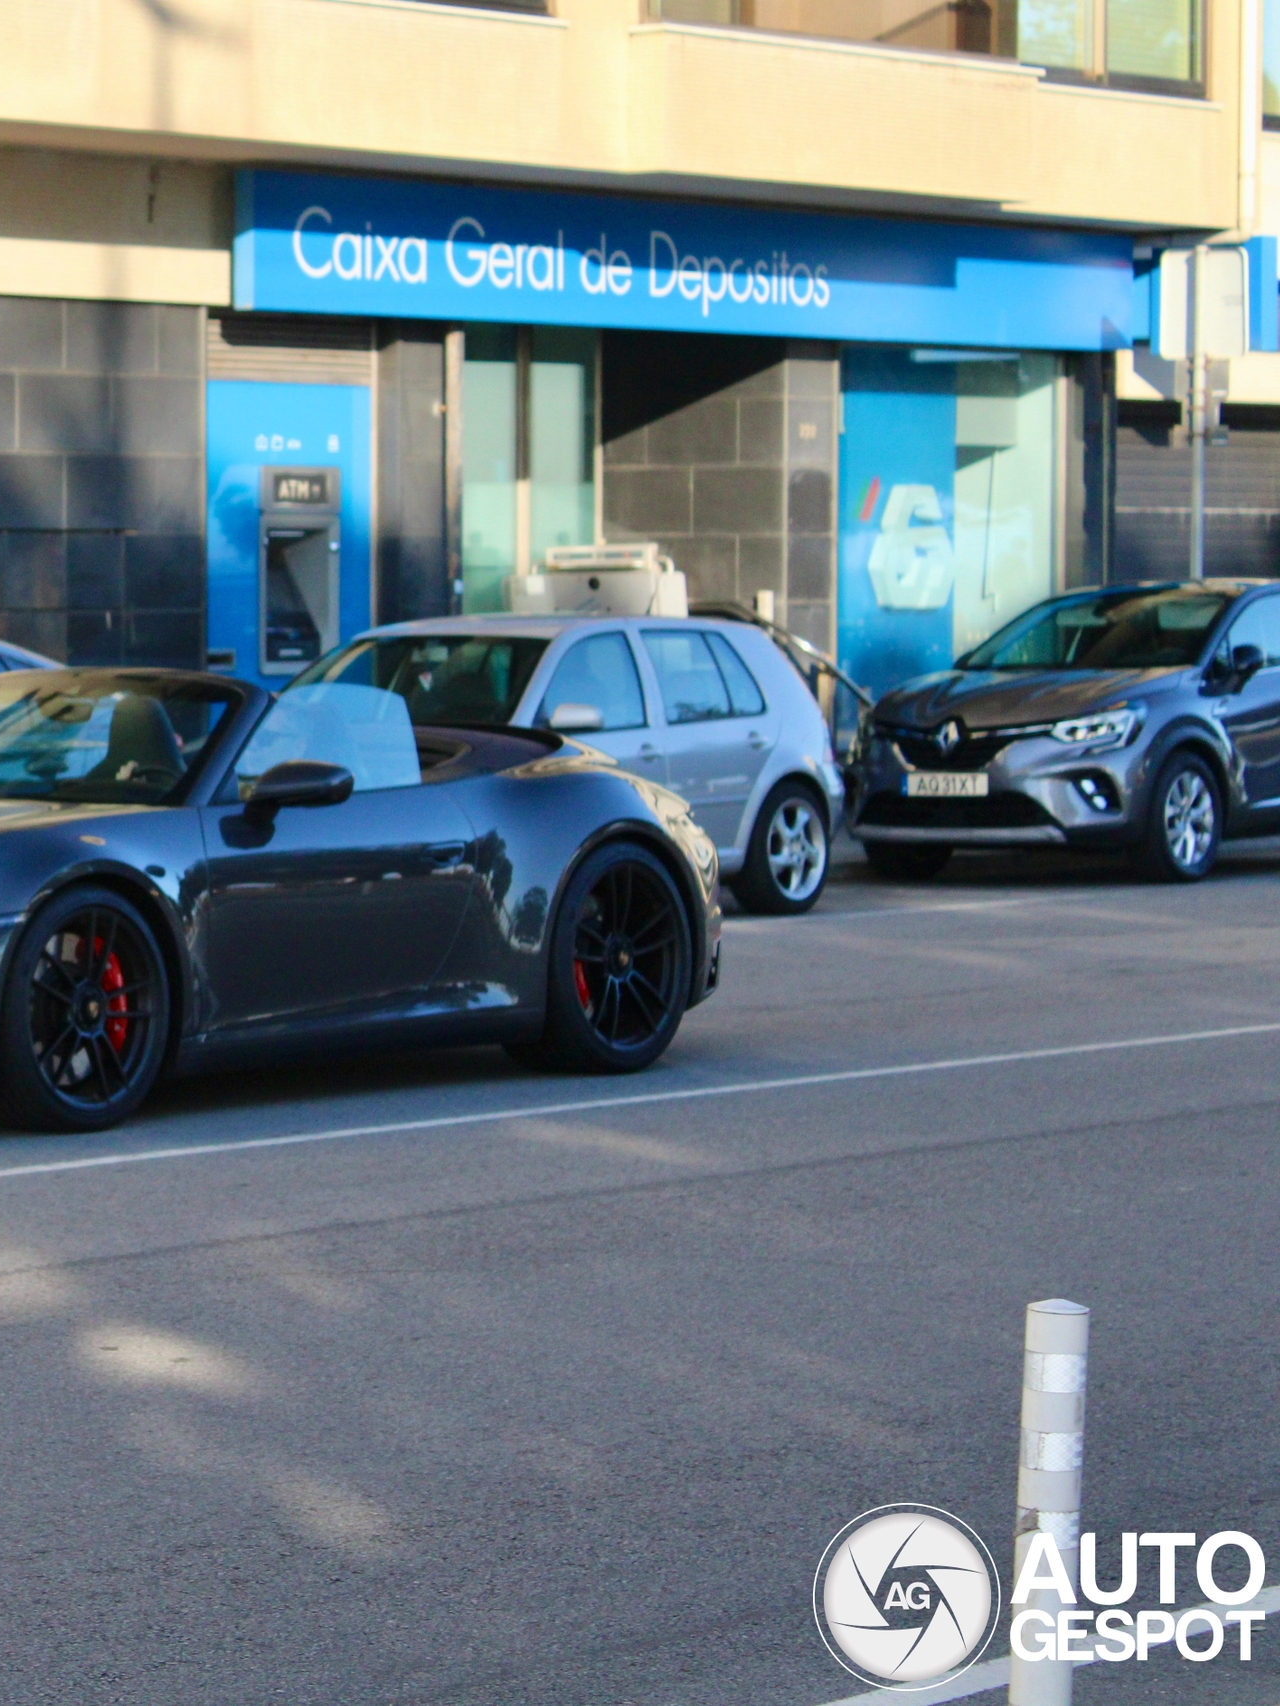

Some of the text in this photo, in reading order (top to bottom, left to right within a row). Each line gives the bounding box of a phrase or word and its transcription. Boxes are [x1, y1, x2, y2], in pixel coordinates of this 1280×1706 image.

[293, 206, 426, 284] Caixa
[446, 217, 564, 290] Geral
[580, 233, 632, 295] de
[278, 479, 309, 500] ATM
